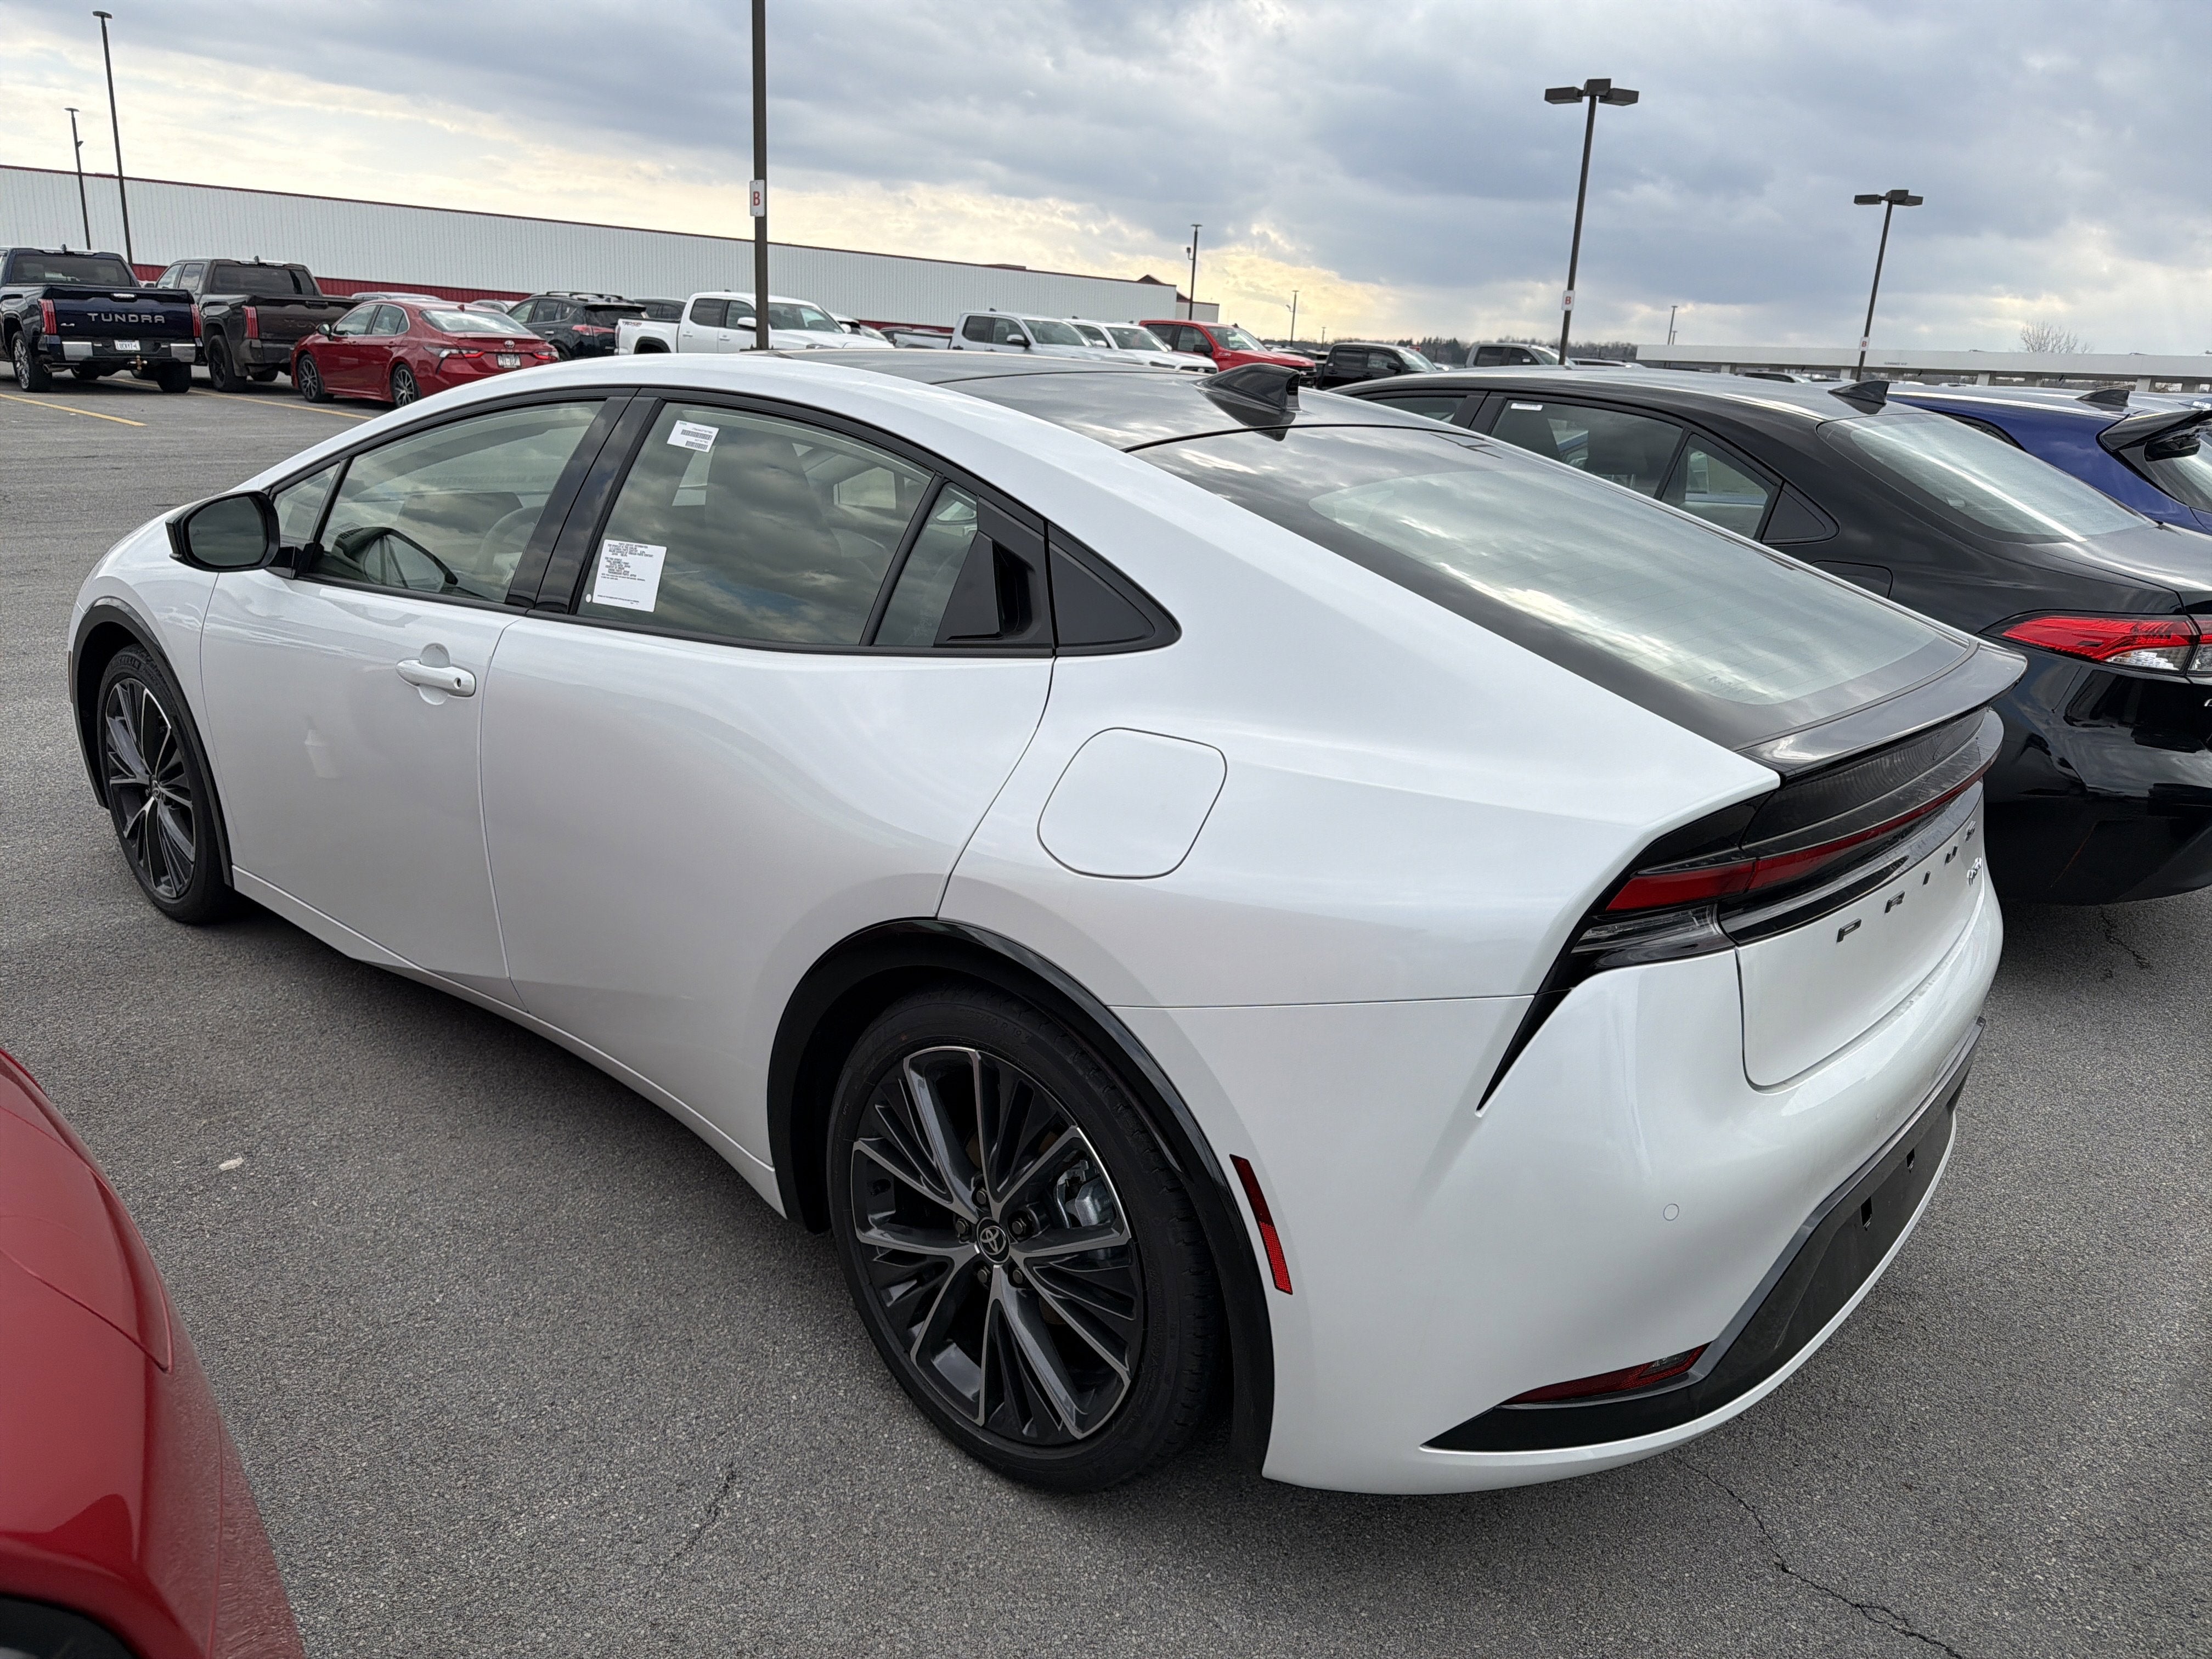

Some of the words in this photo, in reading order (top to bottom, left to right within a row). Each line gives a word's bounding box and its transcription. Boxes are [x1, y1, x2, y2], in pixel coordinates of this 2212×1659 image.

[753, 191, 760, 206] B
[1565, 296, 1571, 304] B
[87, 313, 165, 324] TUNDRA
